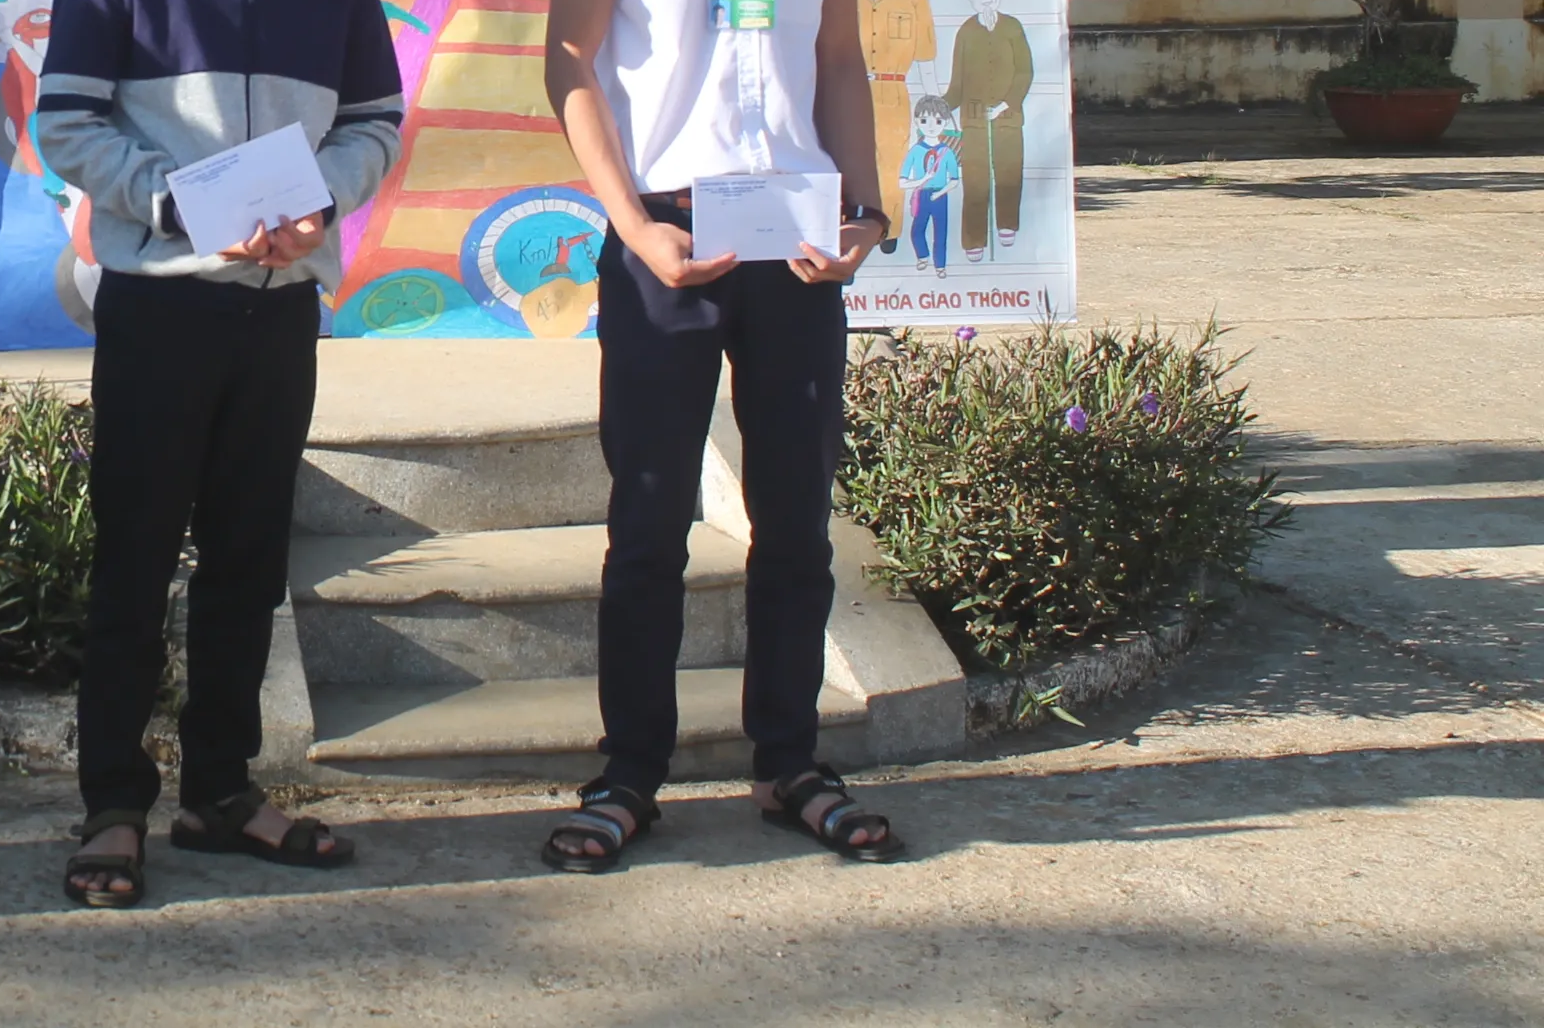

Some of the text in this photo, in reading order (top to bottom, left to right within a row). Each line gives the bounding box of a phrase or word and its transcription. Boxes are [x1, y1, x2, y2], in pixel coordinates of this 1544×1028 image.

[843, 292, 867, 311] ĂN
[875, 287, 913, 311] HÓA
[918, 290, 962, 310] GIAO
[967, 287, 1030, 308] THÔNG
